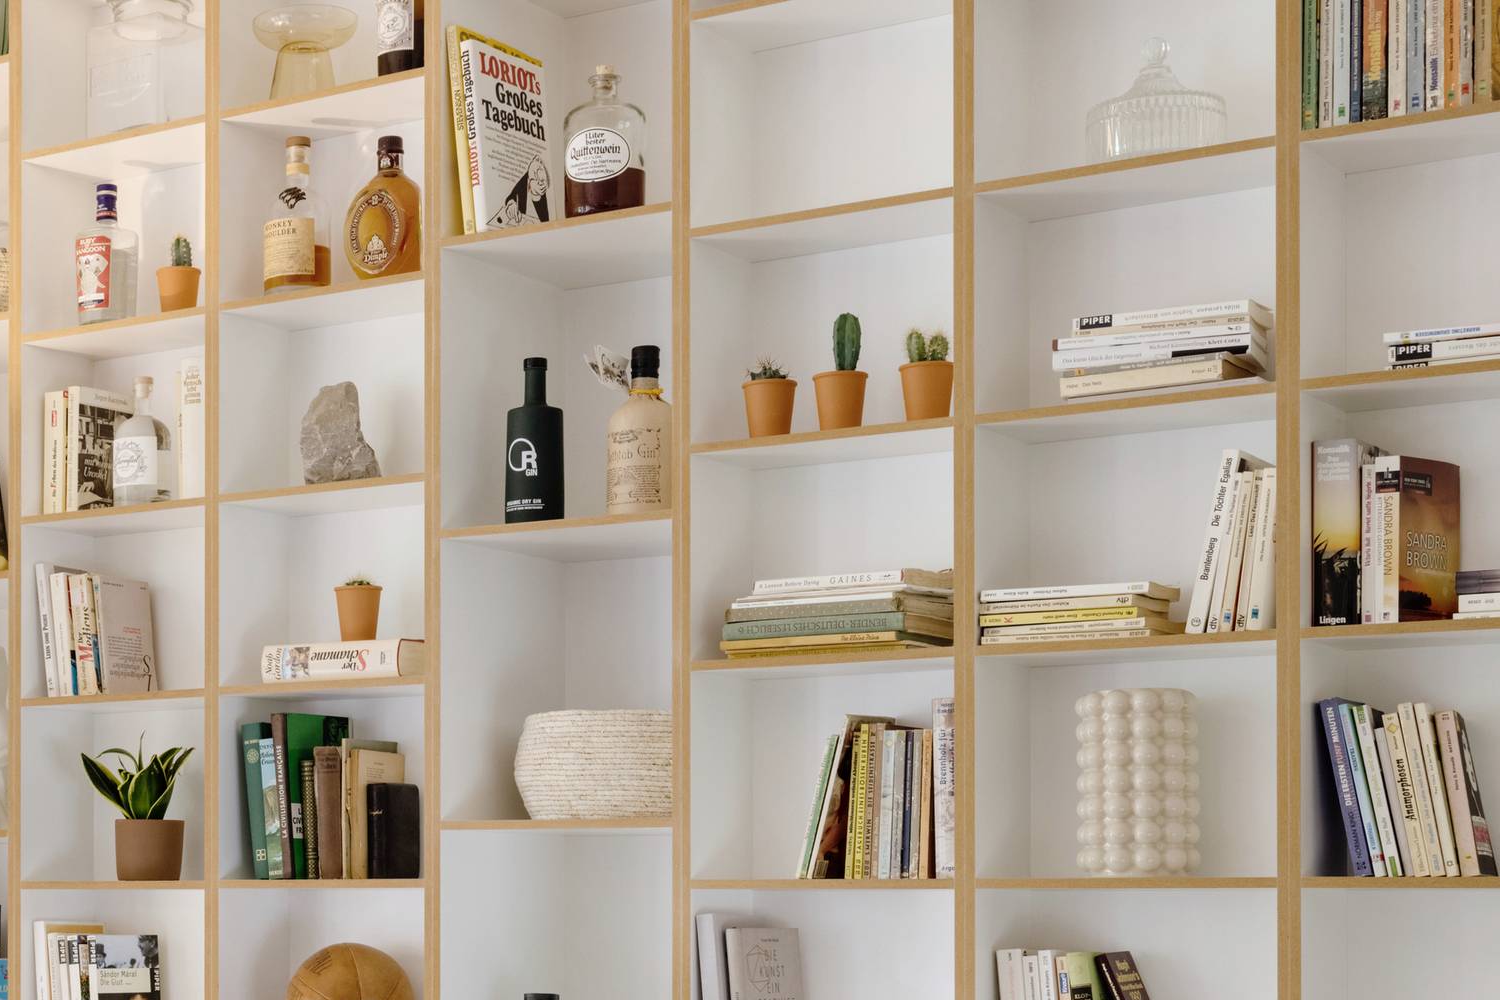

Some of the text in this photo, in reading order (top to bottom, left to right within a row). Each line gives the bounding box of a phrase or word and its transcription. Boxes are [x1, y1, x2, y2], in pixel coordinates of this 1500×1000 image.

[1367, 29, 1382, 82] Konsalik
[1323, 59, 1331, 80] Konsalik
[1429, 57, 1439, 91] Konsalik
[461, 50, 477, 141] Großes Tagebuch
[495, 82, 543, 118] Großes
[481, 99, 546, 141] Tagebuch
[570, 144, 621, 160] Quittenwein
[1082, 314, 1112, 327] PIPER
[1398, 344, 1431, 355] PIPER
[637, 443, 656, 458] Gin
[525, 468, 538, 477] GIN
[1211, 456, 1233, 527] Die Töchter Egalias
[1383, 495, 1394, 577] SANDRA BROWN
[1406, 531, 1448, 550] SANDRA
[1200, 537, 1218, 581] Brantenberg
[1406, 551, 1448, 570] BROWN
[784, 580, 803, 588] Before
[803, 579, 820, 588] Dying
[829, 574, 873, 585] GAINES
[1116, 596, 1130, 604] dtv
[746, 622, 797, 633] LESEBUCH
[1209, 616, 1218, 630] dtv
[1237, 613, 1245, 628] dtv
[1318, 615, 1347, 626] Lingen
[76, 606, 94, 663] Medicus
[265, 652, 273, 675] Noah
[275, 647, 283, 680] Gordon
[310, 648, 370, 672] Schamane
[341, 662, 357, 671] Der
[1326, 706, 1340, 743] MINUTEN
[938, 729, 949, 785] Brennholz für
[1335, 743, 1346, 764] FÜNF
[1338, 764, 1350, 792] ERSTEN
[276, 745, 289, 839] LA CIVILISATION FRANÇAISE
[1343, 792, 1353, 806] DIE
[1395, 757, 1417, 822] Anamorphosen
[856, 815, 864, 855] TAGEBUCH
[1348, 811, 1363, 859] NORMAN KING
[764, 949, 778, 962] DIE
[100, 978, 124, 986] Die Glut
[759, 965, 785, 978] KUNST
[766, 982, 781, 994] EIN
